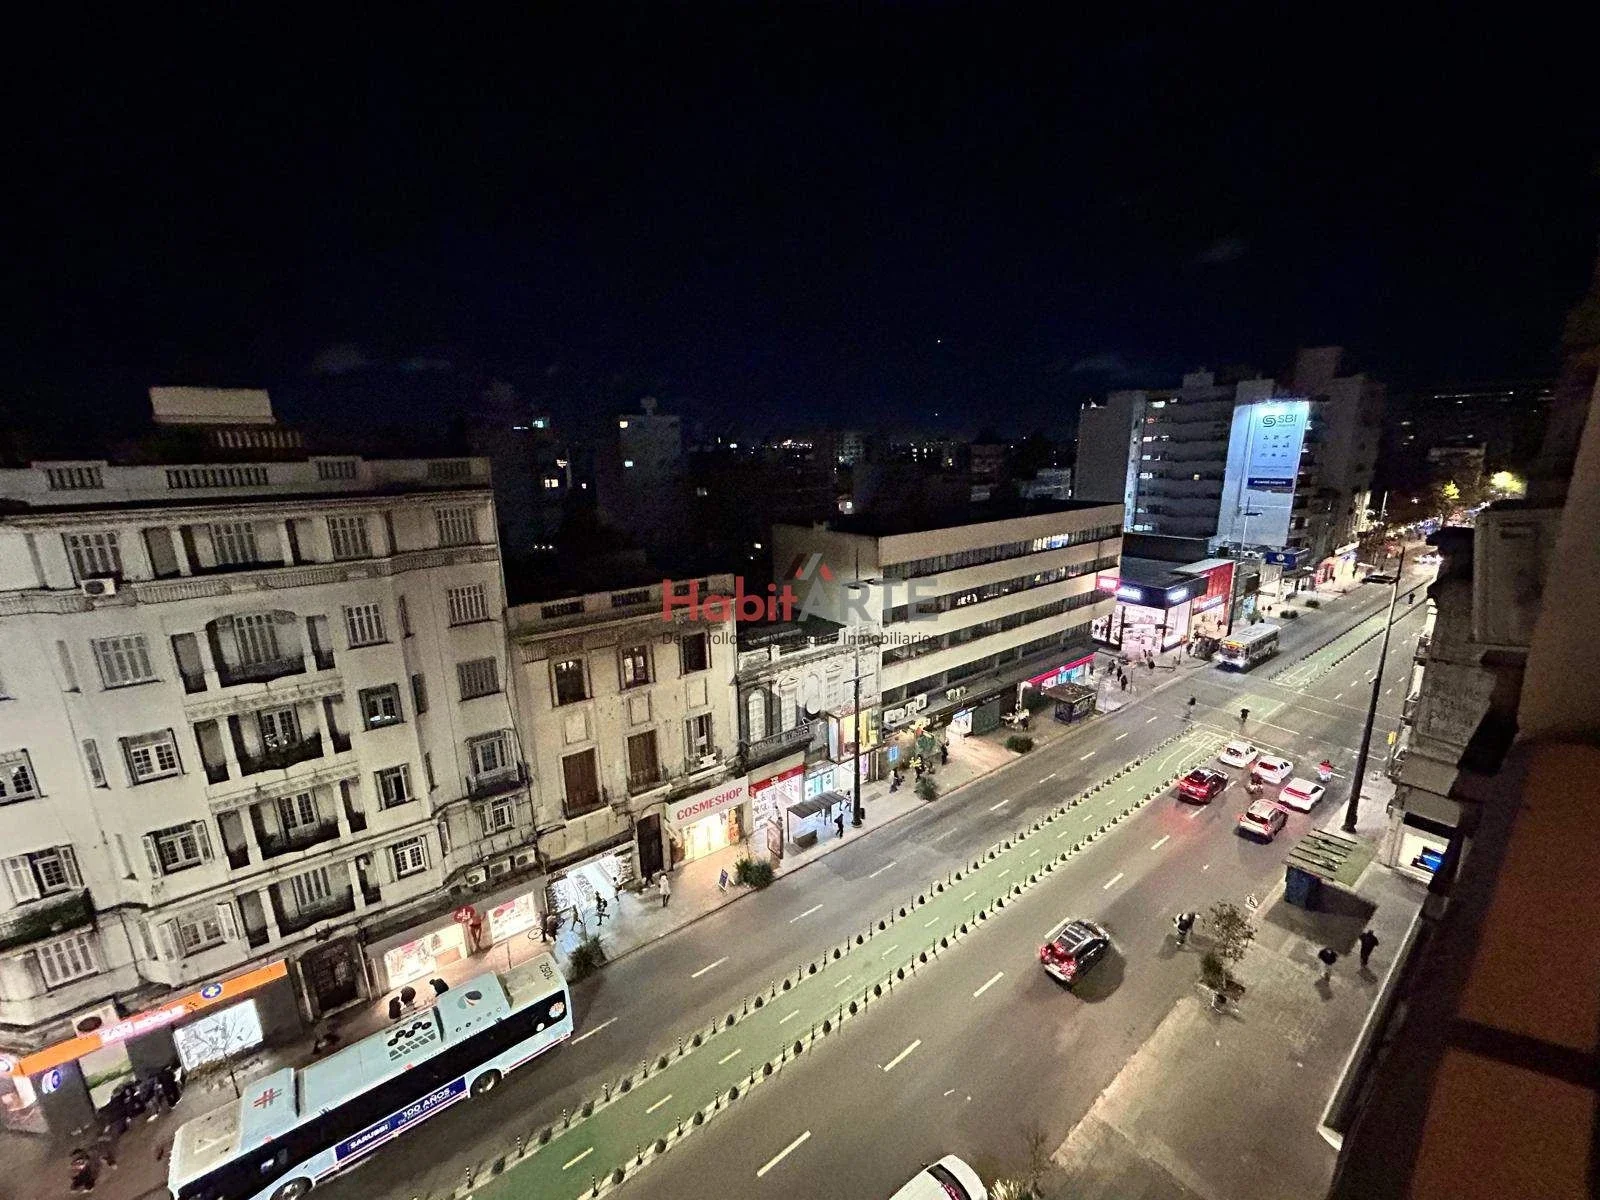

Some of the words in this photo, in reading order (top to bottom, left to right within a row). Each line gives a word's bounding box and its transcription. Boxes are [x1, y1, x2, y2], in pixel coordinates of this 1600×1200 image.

[1277, 414, 1297, 423] SBI
[676, 786, 742, 820] COSMESHOP
[539, 962, 554, 980] 1052
[402, 1105, 421, 1118] 100
[422, 1088, 450, 1107] AÑOS
